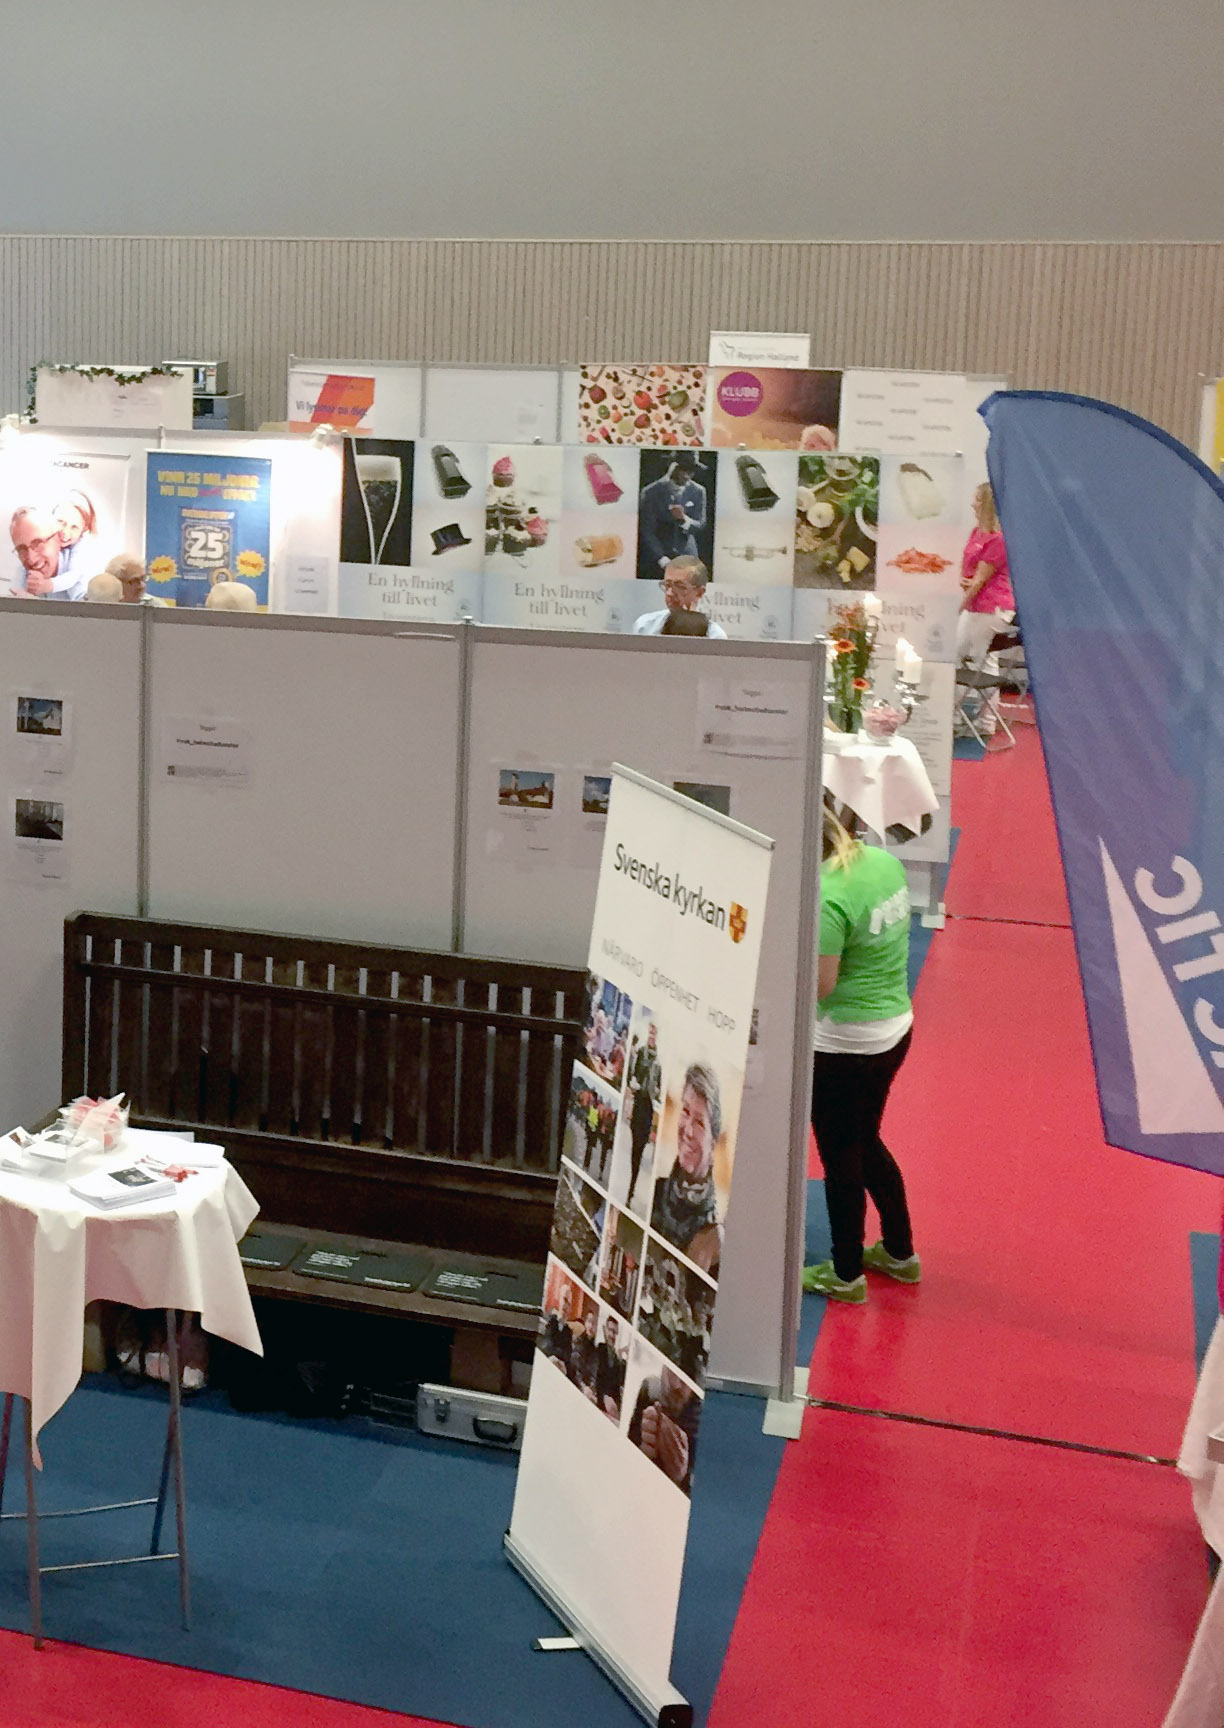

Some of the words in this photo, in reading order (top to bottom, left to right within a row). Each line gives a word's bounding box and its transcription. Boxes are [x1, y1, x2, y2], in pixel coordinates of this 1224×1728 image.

[189, 529, 225, 560] 25
[368, 572, 387, 587] En
[392, 574, 455, 595] hyllning
[514, 582, 535, 597] En
[540, 583, 605, 604] hyllning
[382, 591, 401, 604] till
[405, 591, 437, 607] livet
[529, 600, 549, 614] till
[554, 601, 587, 617] livet
[614, 843, 672, 900] Svenska
[672, 873, 726, 931] kyrkan
[650, 967, 700, 1013] ÖPPENHET
[707, 1001, 736, 1034] HOPP
